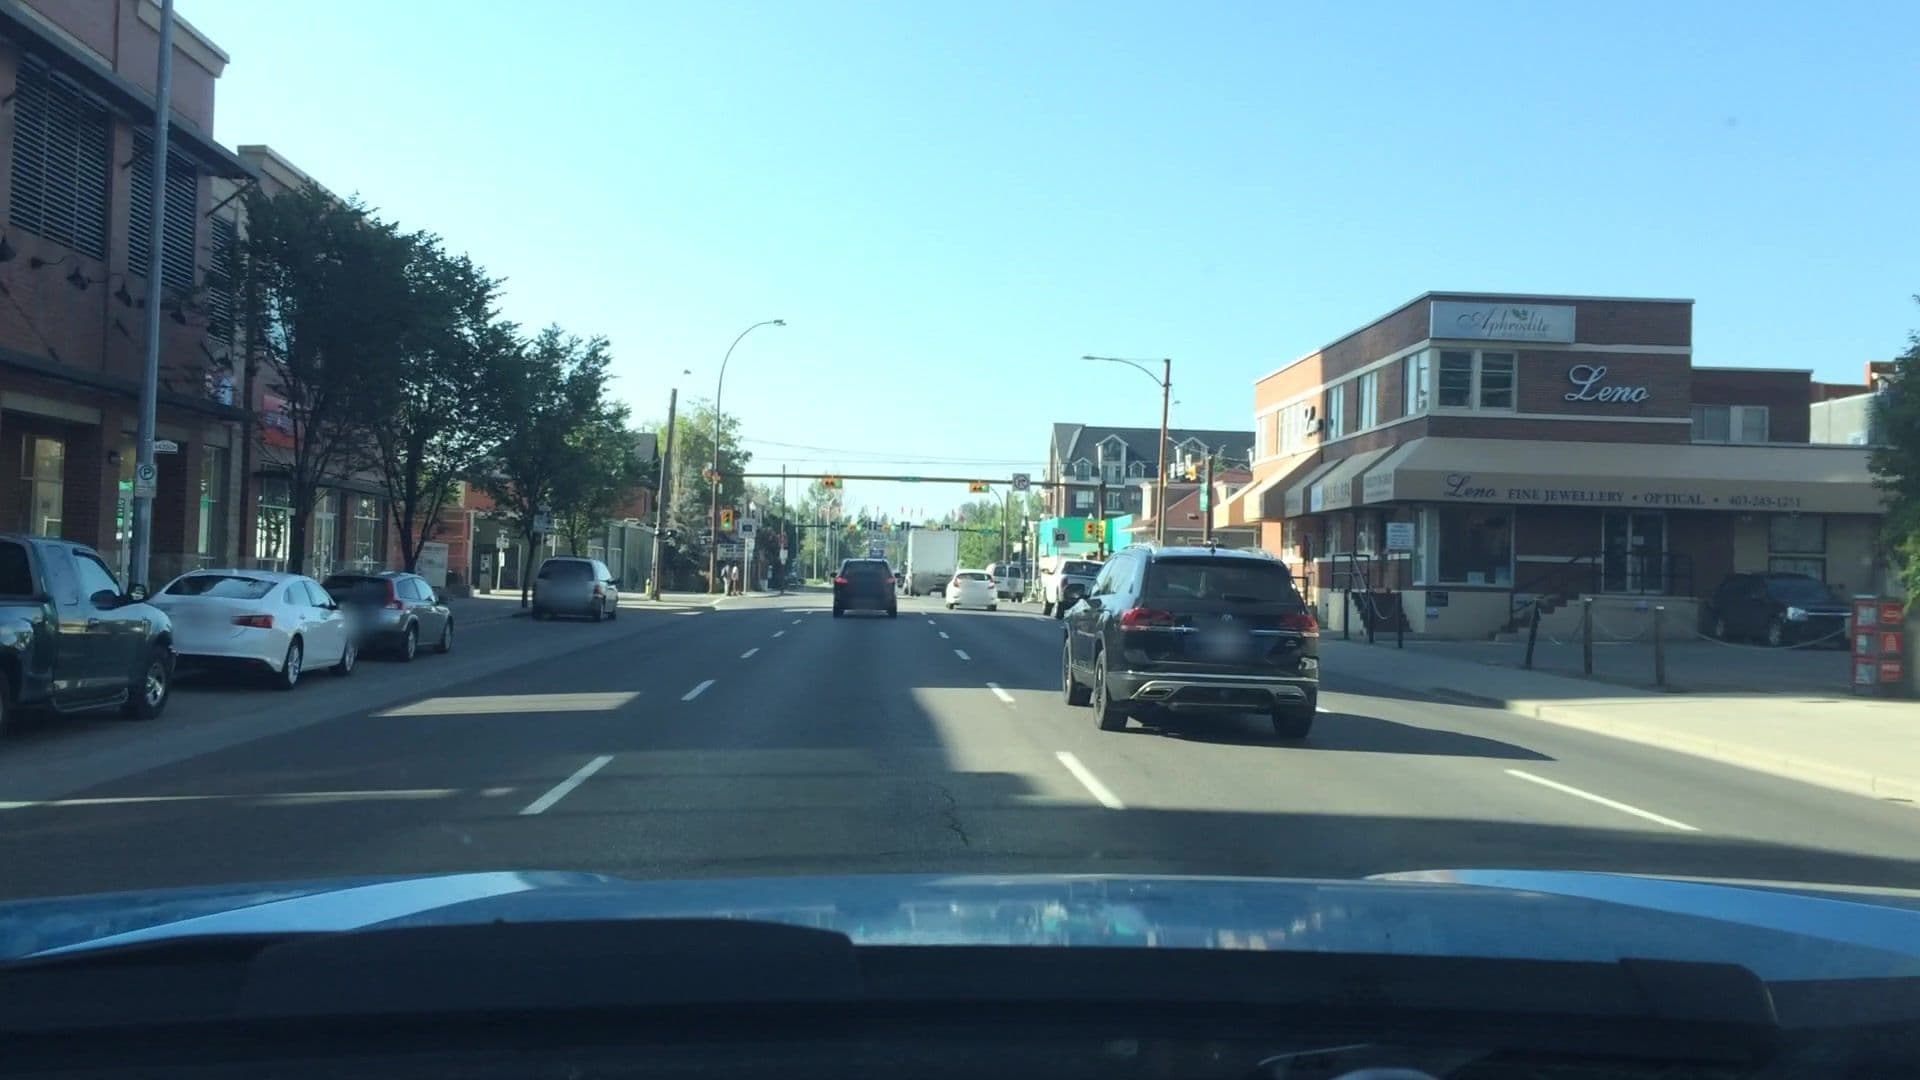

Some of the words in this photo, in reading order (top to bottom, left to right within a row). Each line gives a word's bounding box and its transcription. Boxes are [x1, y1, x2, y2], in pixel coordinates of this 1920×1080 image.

[1457, 306, 1550, 338] Aphrodite
[1564, 364, 1650, 403] Leno
[1444, 473, 1497, 498] Leno
[1508, 488, 1540, 501] FINE
[1545, 489, 1625, 503] JEWELLERY
[1643, 493, 1706, 506] OPTICAL
